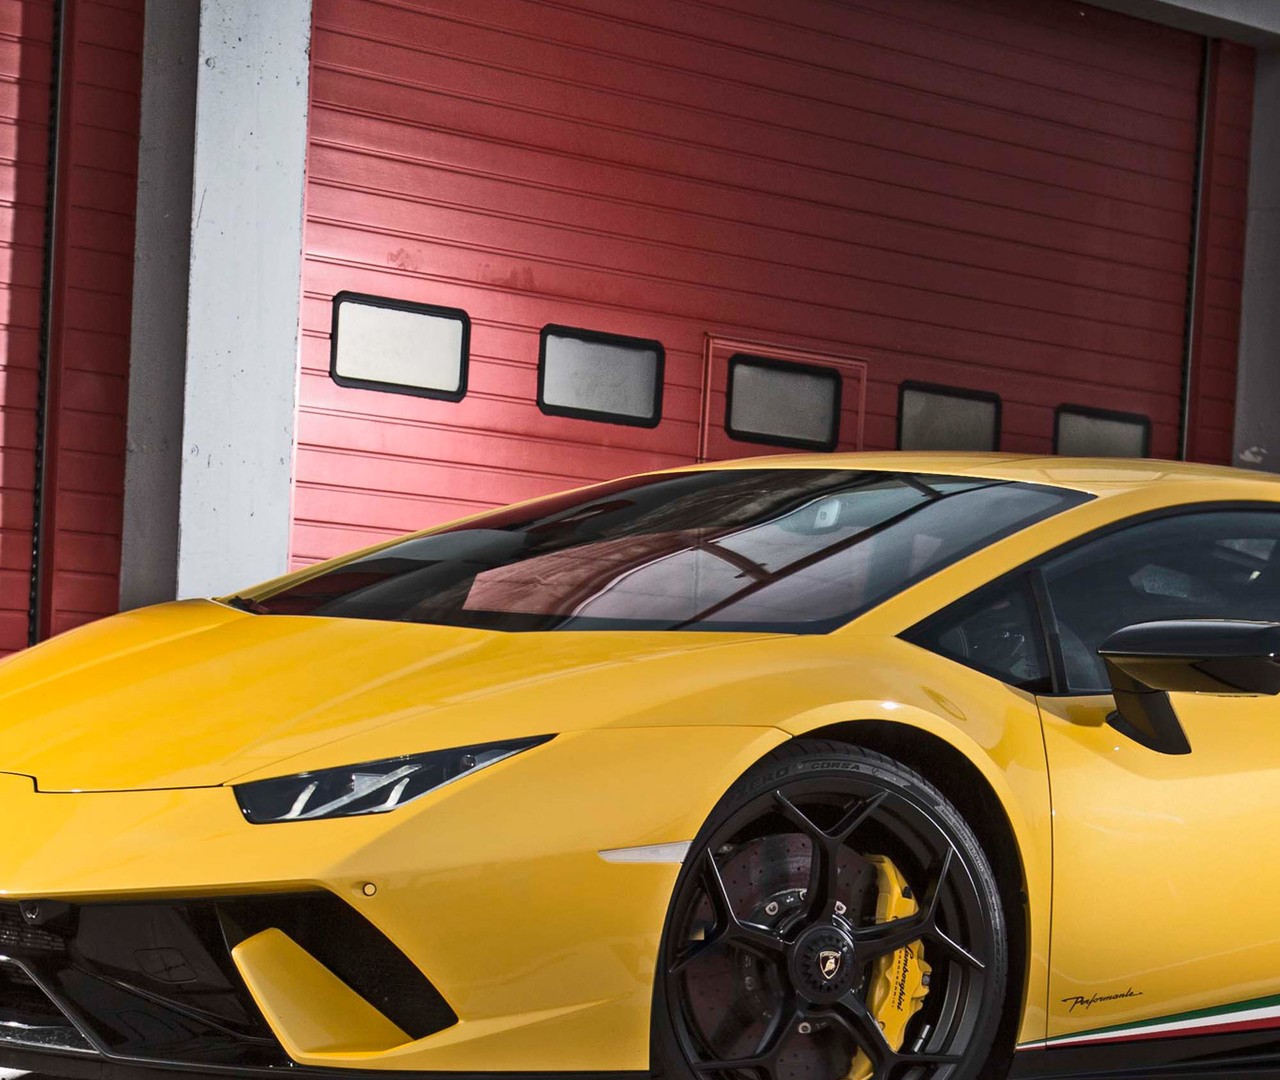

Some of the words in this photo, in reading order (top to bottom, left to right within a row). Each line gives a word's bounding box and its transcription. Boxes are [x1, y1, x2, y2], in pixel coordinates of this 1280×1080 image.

[810, 761, 861, 772] CORSA
[897, 945, 915, 1012] Lamborghini
[1061, 987, 1144, 1013] Performante
